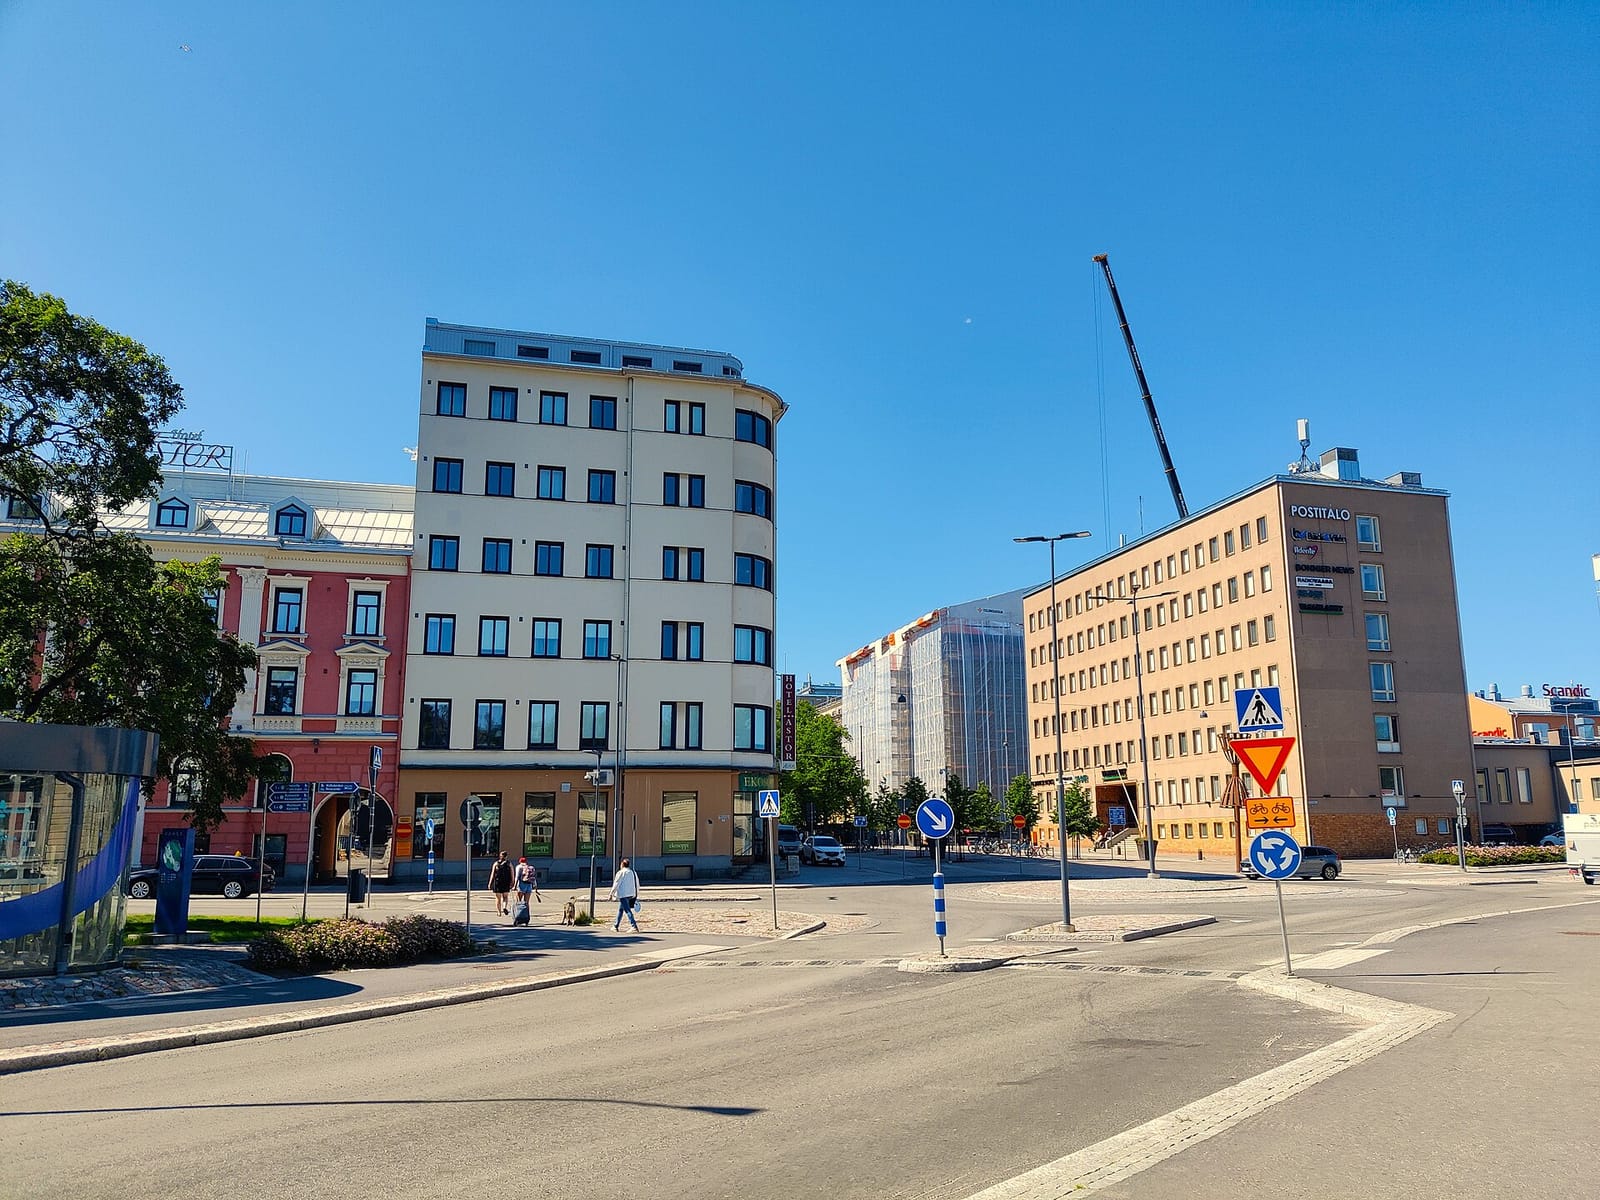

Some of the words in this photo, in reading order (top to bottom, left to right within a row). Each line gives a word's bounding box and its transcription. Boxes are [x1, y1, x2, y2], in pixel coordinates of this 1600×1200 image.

[155, 440, 232, 470] STOR
[1291, 505, 1351, 521] POSTITALO
[785, 675, 793, 714] HOTEL
[1542, 683, 1591, 697] Scandic
[785, 718, 793, 761] ASTOR
